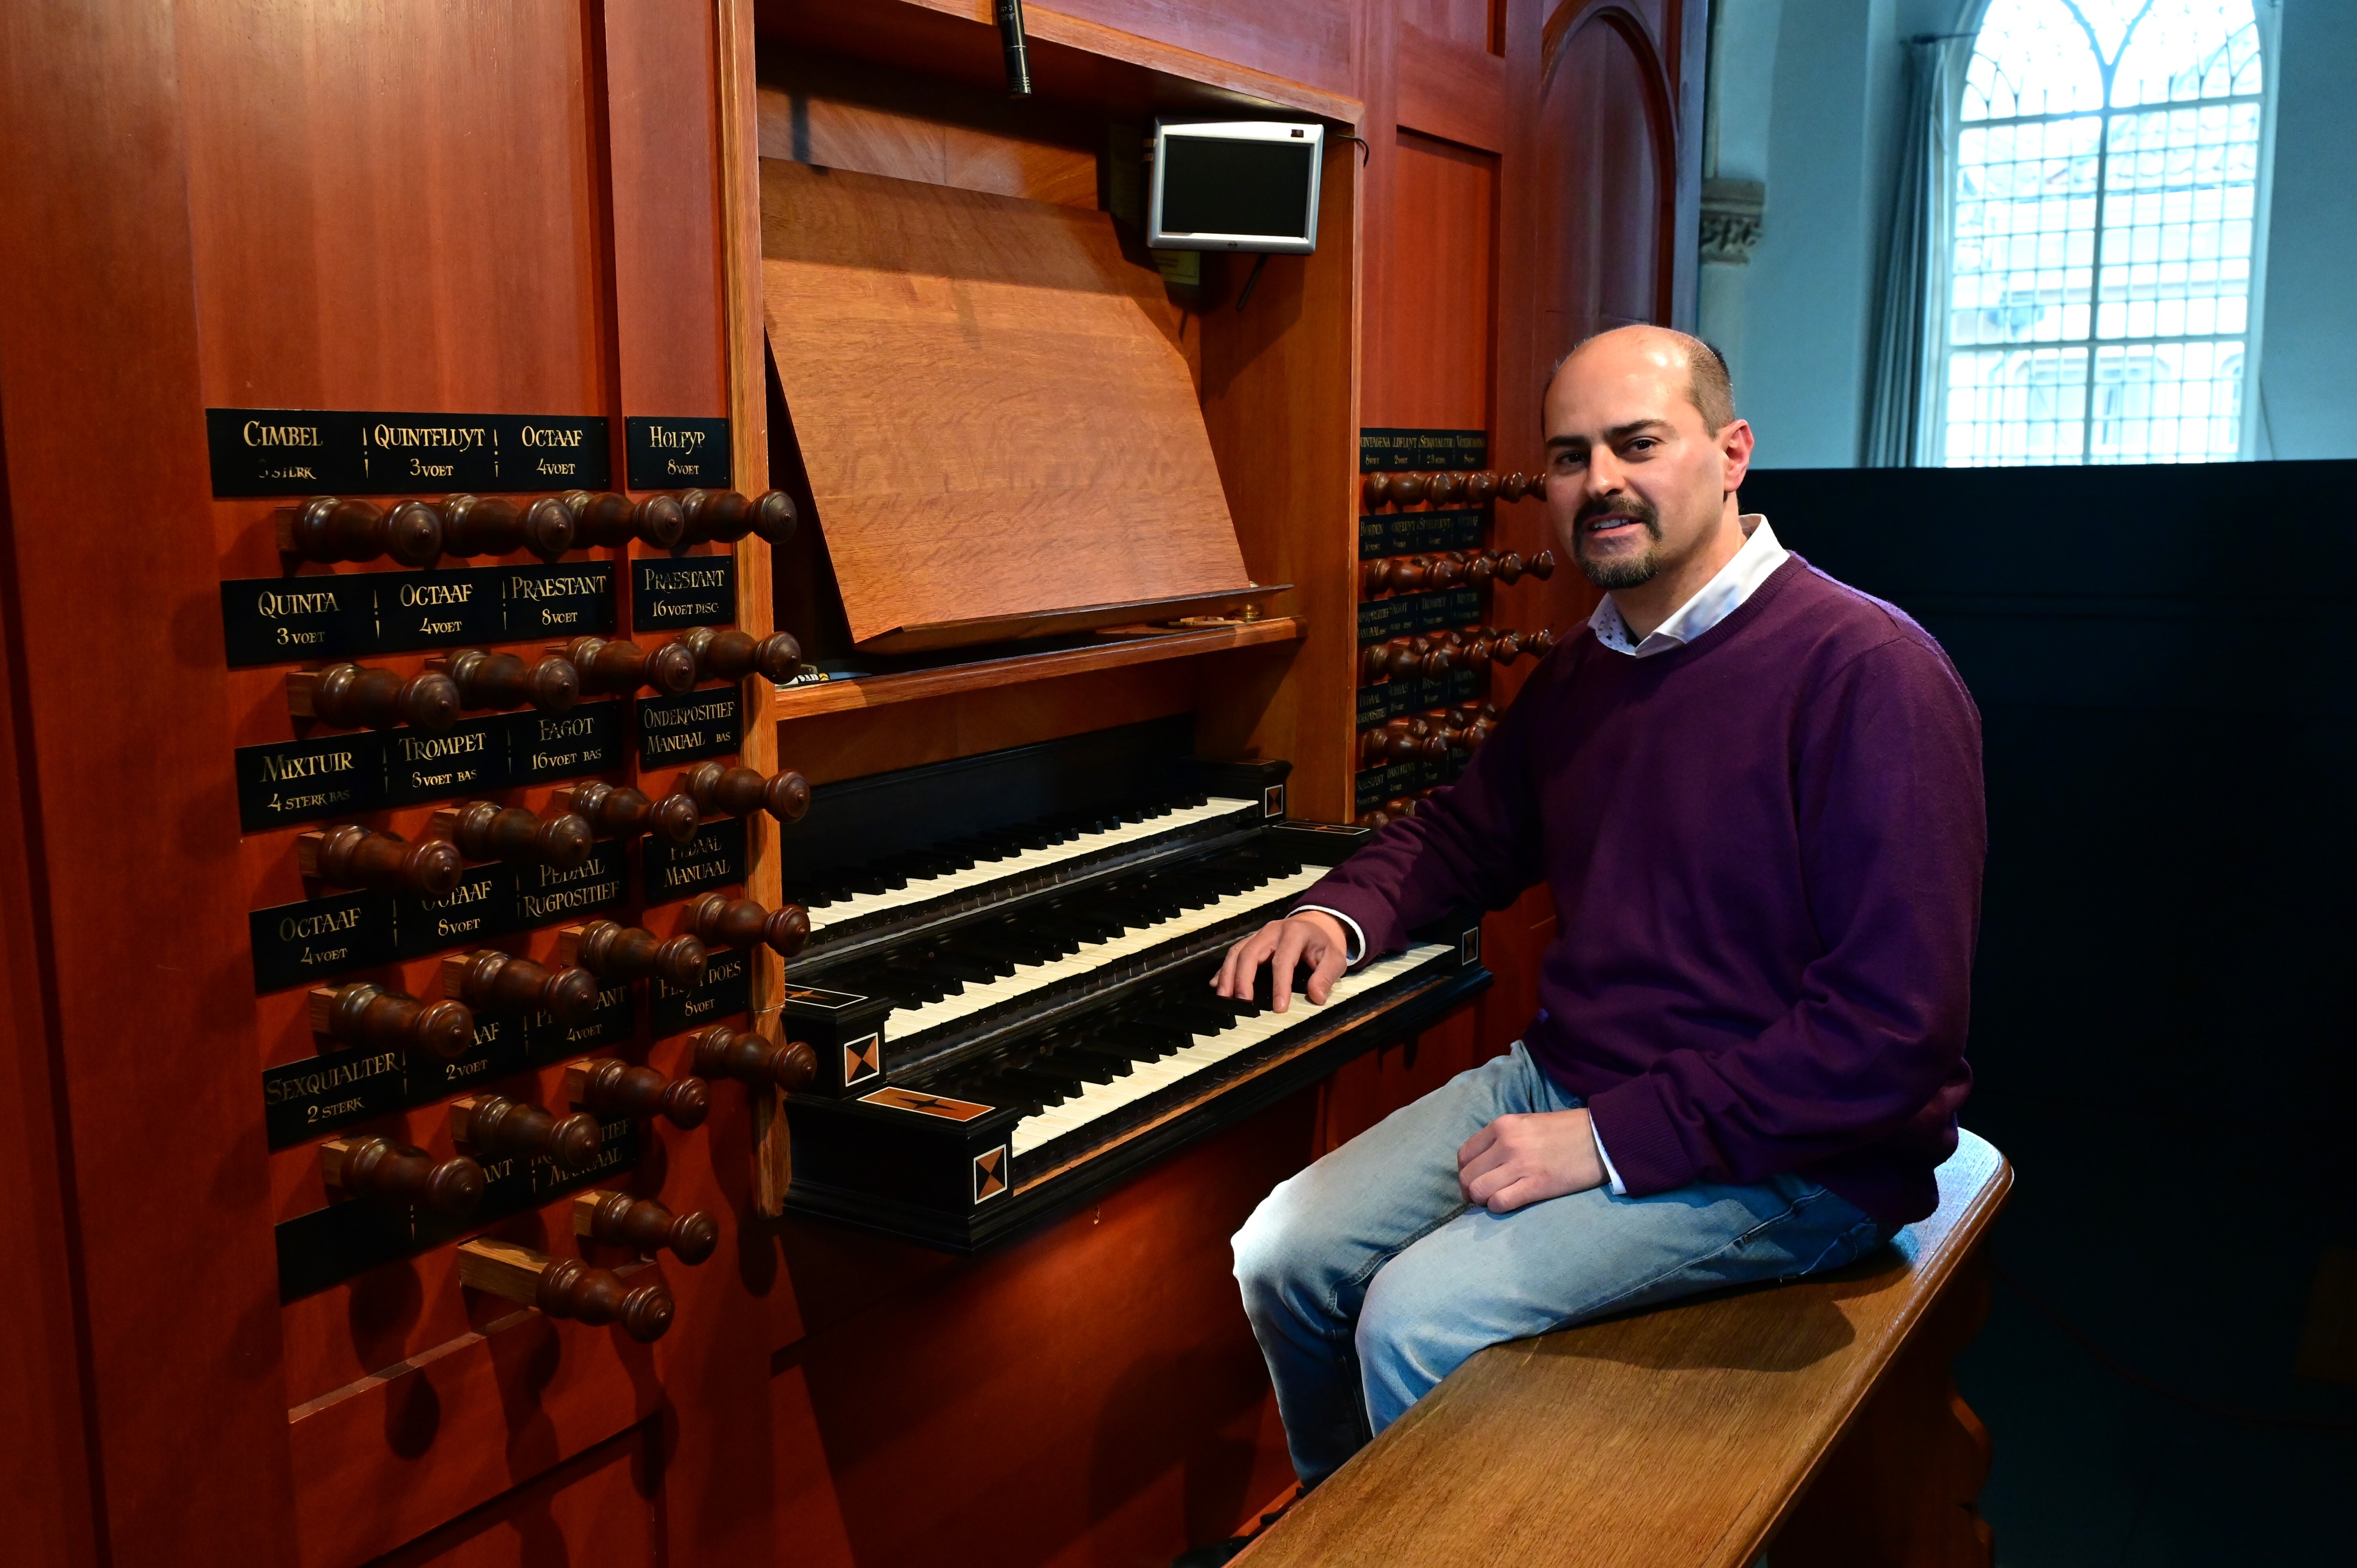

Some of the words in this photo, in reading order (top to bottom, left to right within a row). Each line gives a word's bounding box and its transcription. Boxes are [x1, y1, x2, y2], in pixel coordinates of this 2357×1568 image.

[243, 420, 322, 446] CIMBEL
[375, 424, 485, 452] QUINTFLUYT
[522, 426, 583, 447] OCTAAF
[649, 426, 705, 454] HOLPYP
[512, 576, 606, 601] PRAESTANT
[645, 569, 724, 593] PRAESTANT
[258, 591, 340, 619] QUINTA
[401, 584, 473, 607] OCTAAF
[645, 701, 735, 728] ONDERPOSITIEF
[399, 733, 486, 760] TROMPET
[583, 749, 601, 761] BAS
[647, 732, 705, 754] MANUAAL
[716, 732, 730, 742] BAS
[457, 770, 476, 781] BAS
[285, 794, 327, 810] STERK
[664, 859, 731, 888] MANUAAL
[523, 880, 620, 918] RUGPOSITIEF
[278, 907, 361, 942] OCTAAF
[709, 961, 741, 983] DOES
[266, 1051, 403, 1105] SEXQUIALTER
[322, 1097, 364, 1118] STERK
